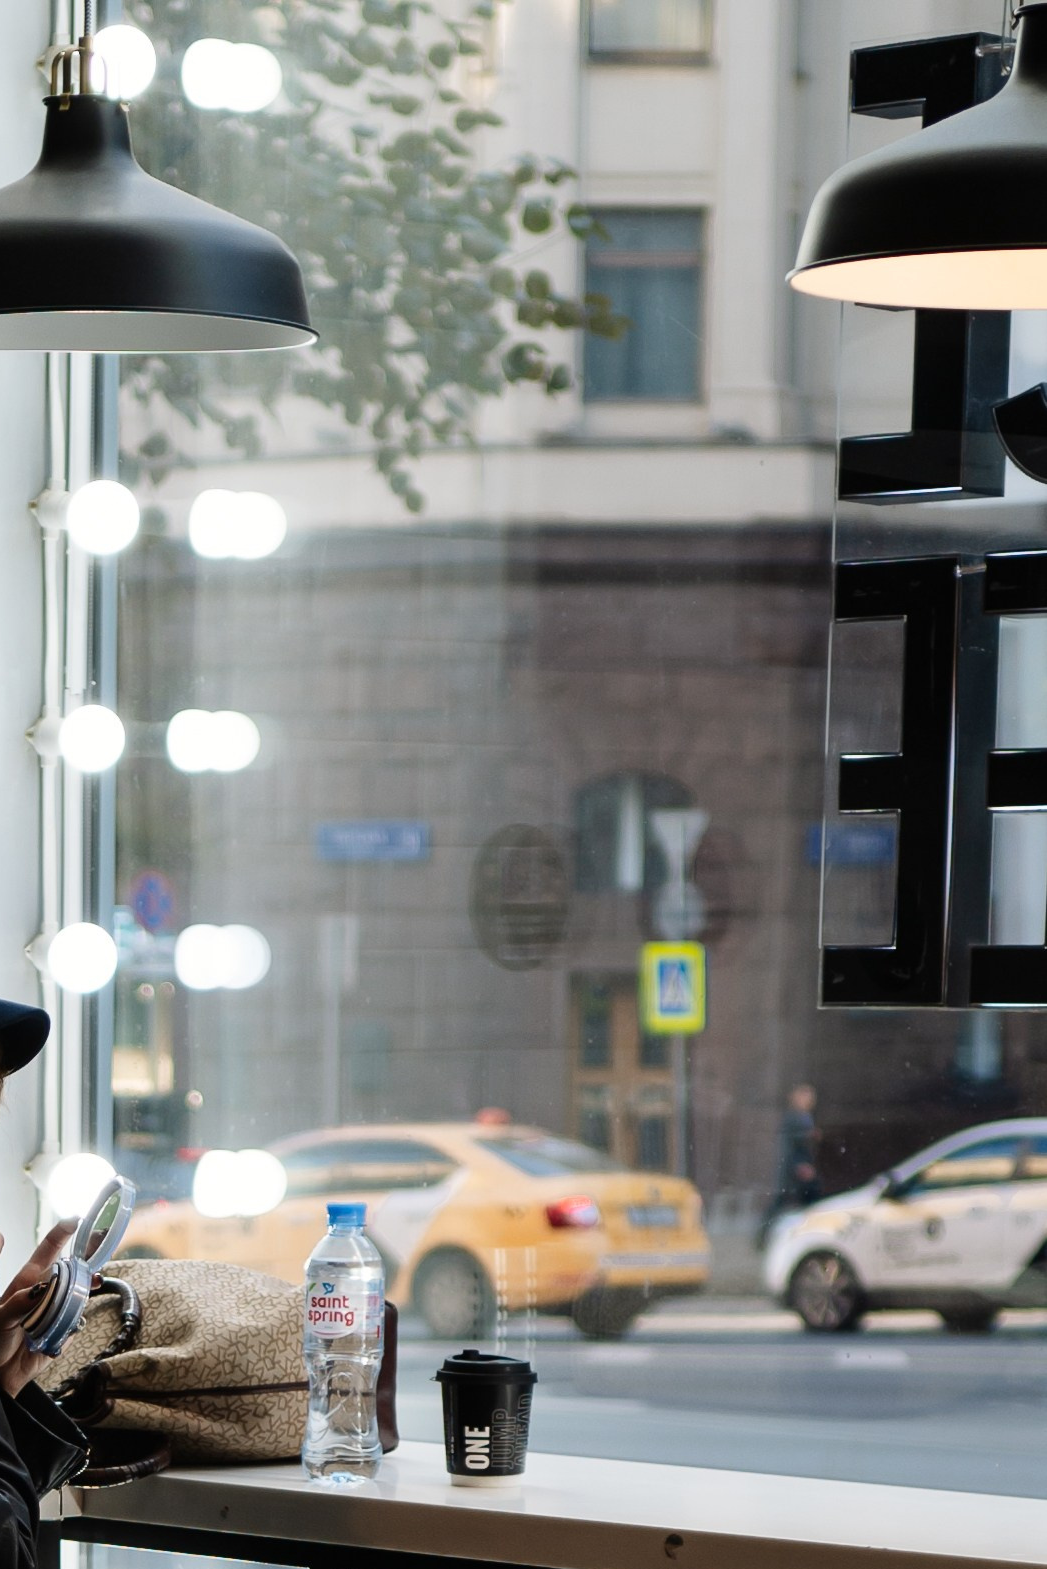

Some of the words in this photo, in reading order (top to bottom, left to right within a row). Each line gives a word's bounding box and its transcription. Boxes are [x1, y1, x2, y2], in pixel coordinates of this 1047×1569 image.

[311, 1295, 350, 1309] saint
[308, 1310, 355, 1327] spring
[464, 1425, 491, 1470] ONE
[491, 1407, 517, 1470] JUMP
